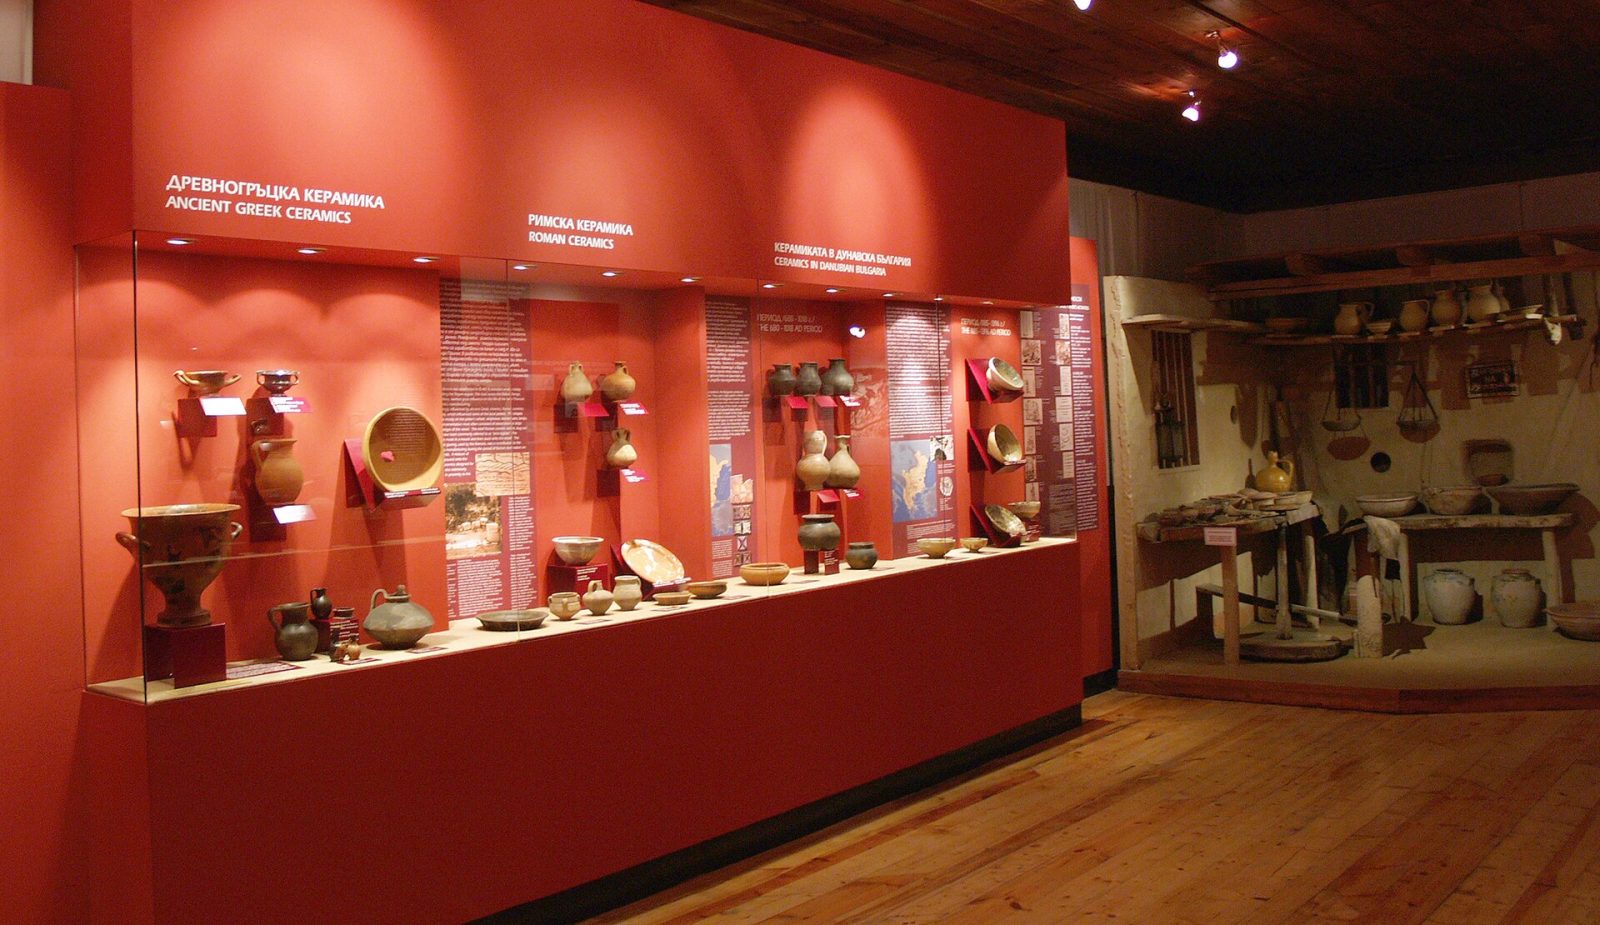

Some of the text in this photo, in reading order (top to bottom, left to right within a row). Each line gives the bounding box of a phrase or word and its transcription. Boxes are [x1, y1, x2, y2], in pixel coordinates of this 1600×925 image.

[165, 174, 385, 209] ДРЕВНОГРЪЦКА КЕРАМИКА
[165, 195, 352, 224] ANCIENT GREEK CERAMICS
[528, 213, 634, 235] РИМСКА КЕРАМИКА
[528, 231, 614, 249] ROMAN CERAMICS
[774, 242, 912, 266] КЕРАМИКАТА В ДУНАВСКА БЪЛГАРИЯ
[774, 256, 887, 276] CERAMICS IN DANUBIAN BULGARIA
